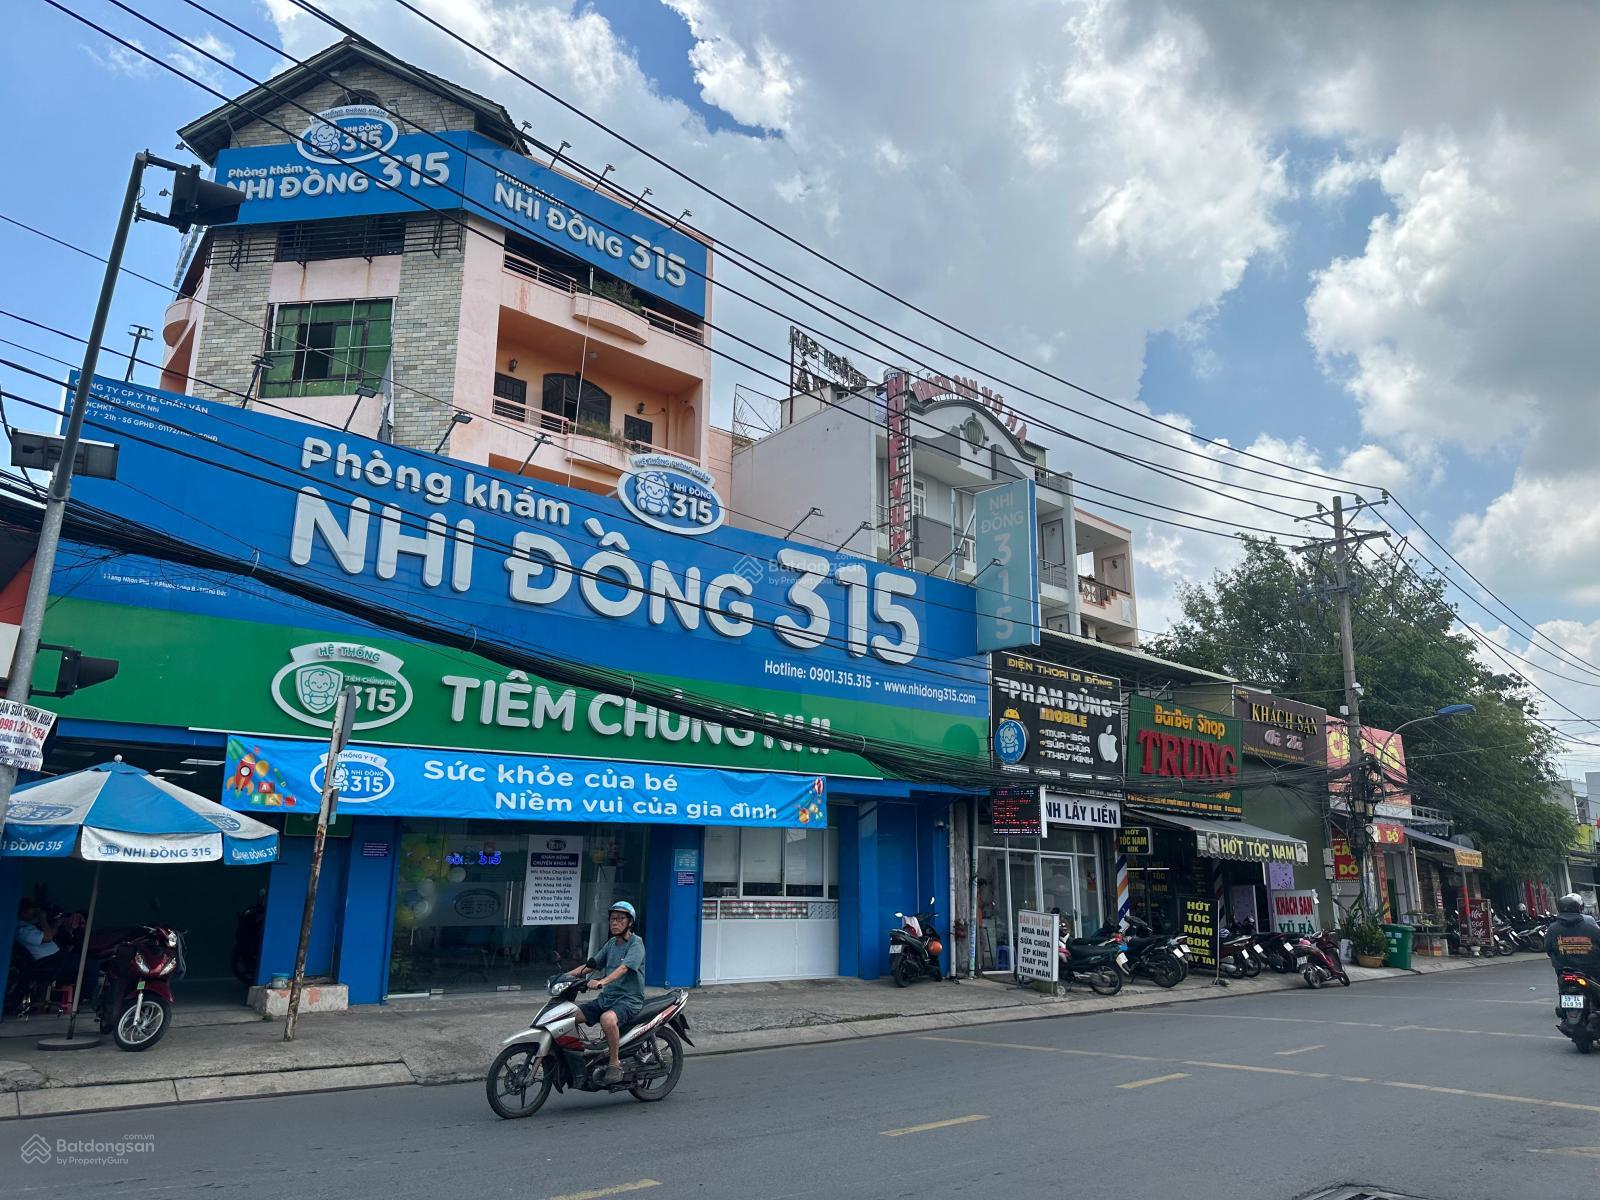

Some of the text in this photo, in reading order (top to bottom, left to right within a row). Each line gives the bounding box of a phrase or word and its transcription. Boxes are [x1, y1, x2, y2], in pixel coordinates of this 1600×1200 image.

[358, 122, 383, 132] ĐỒNG
[341, 130, 383, 152] 315
[228, 162, 303, 180] Phòng khám
[279, 164, 368, 199] ĐỒNG
[378, 151, 451, 191] 315
[494, 182, 688, 288] NHI ĐỒNG 315
[121, 388, 135, 398] CP
[302, 436, 570, 526] Phòng khám
[673, 482, 713, 501] NHI ĐỒNG
[671, 493, 713, 524] 315
[981, 492, 1025, 534] NHI ĐỒNG
[289, 486, 921, 664] NHI ĐỒNG 315
[319, 643, 381, 662] HỆ THỐNG
[1007, 657, 1034, 674] ĐIỆN
[764, 660, 977, 706] Hotline: 0901.315.315 www.nhidong315.com
[441, 669, 577, 733] TIÊM
[1045, 750, 1095, 765] THAY KÍNH
[1137, 727, 1238, 784] TRUNG
[364, 767, 384, 776] ĐỒNG
[424, 759, 679, 792] Sức khỏe của bé
[350, 776, 385, 793] 315
[495, 789, 778, 820] Niềm vui của gia đình
[1065, 800, 1087, 820] LẤY
[1090, 803, 1118, 824] LIỀN
[10, 838, 46, 851] ĐỒNG
[45, 840, 64, 852] 315
[1132, 836, 1147, 846] NAM
[1221, 835, 1296, 861] HỚT TÓC NAM
[122, 845, 212, 858] NHI ĐỒNG 315
[1186, 900, 1211, 912] HỚT
[1275, 892, 1299, 916] KHÁCH
[1186, 912, 1210, 924] TÓC
[1021, 926, 1035, 936] MUA
[1183, 924, 1213, 936] NAM
[1278, 919, 1316, 935] VŨ HÀ
[1020, 936, 1051, 949] SỬA CHỮA
[1186, 937, 1210, 948] 60K
[1021, 956, 1049, 968] THAY PIN
[1032, 948, 1048, 959] KÍNH
[1202, 956, 1216, 966] TAI
[1019, 966, 1035, 975] THAY
